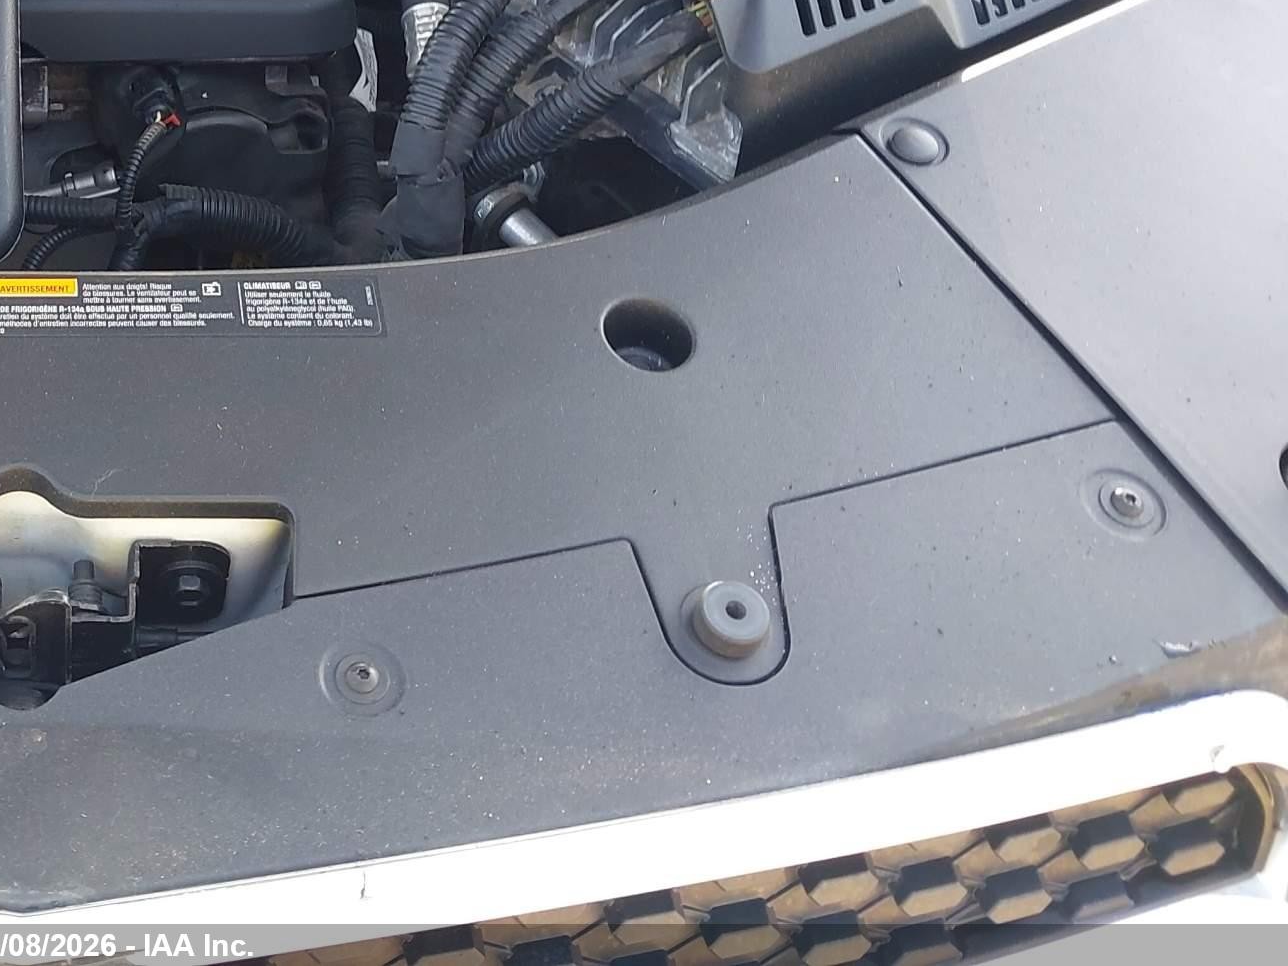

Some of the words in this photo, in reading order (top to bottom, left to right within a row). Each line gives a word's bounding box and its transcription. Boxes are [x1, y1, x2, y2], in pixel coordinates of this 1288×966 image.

[0, 284, 69, 294] AVERTISSEMENT
[243, 282, 291, 290] CLIMATISEUR
[85, 305, 105, 313] SOUS
[106, 305, 130, 313] HAUTE
[130, 305, 167, 313] PRESSION
